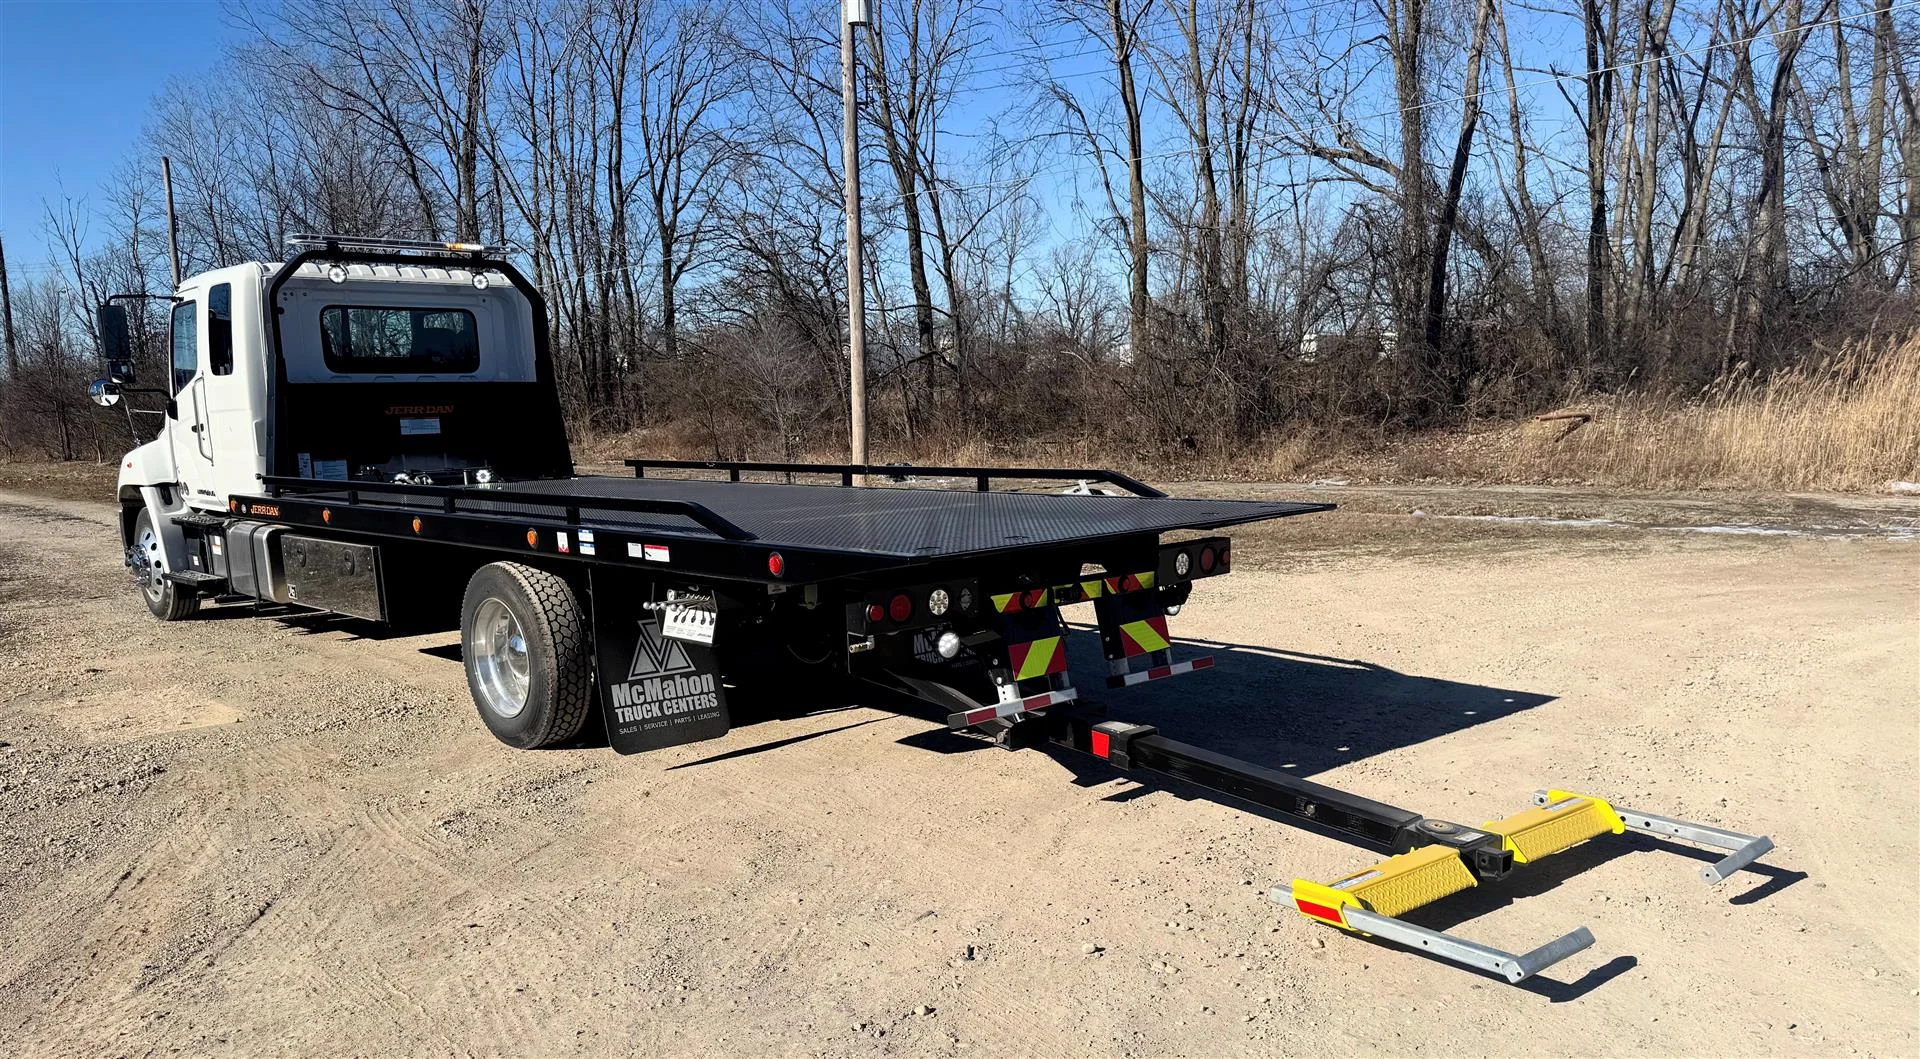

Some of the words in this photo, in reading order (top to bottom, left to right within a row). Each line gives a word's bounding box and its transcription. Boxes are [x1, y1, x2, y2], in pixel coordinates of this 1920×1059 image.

[610, 673, 715, 708] McMahon
[615, 702, 662, 723] TRUCK
[662, 692, 718, 716] CENTERS
[619, 726, 638, 735] SALES
[643, 720, 668, 730] SERVICE
[674, 716, 692, 724] PARTS
[697, 711, 720, 720] LEASING
